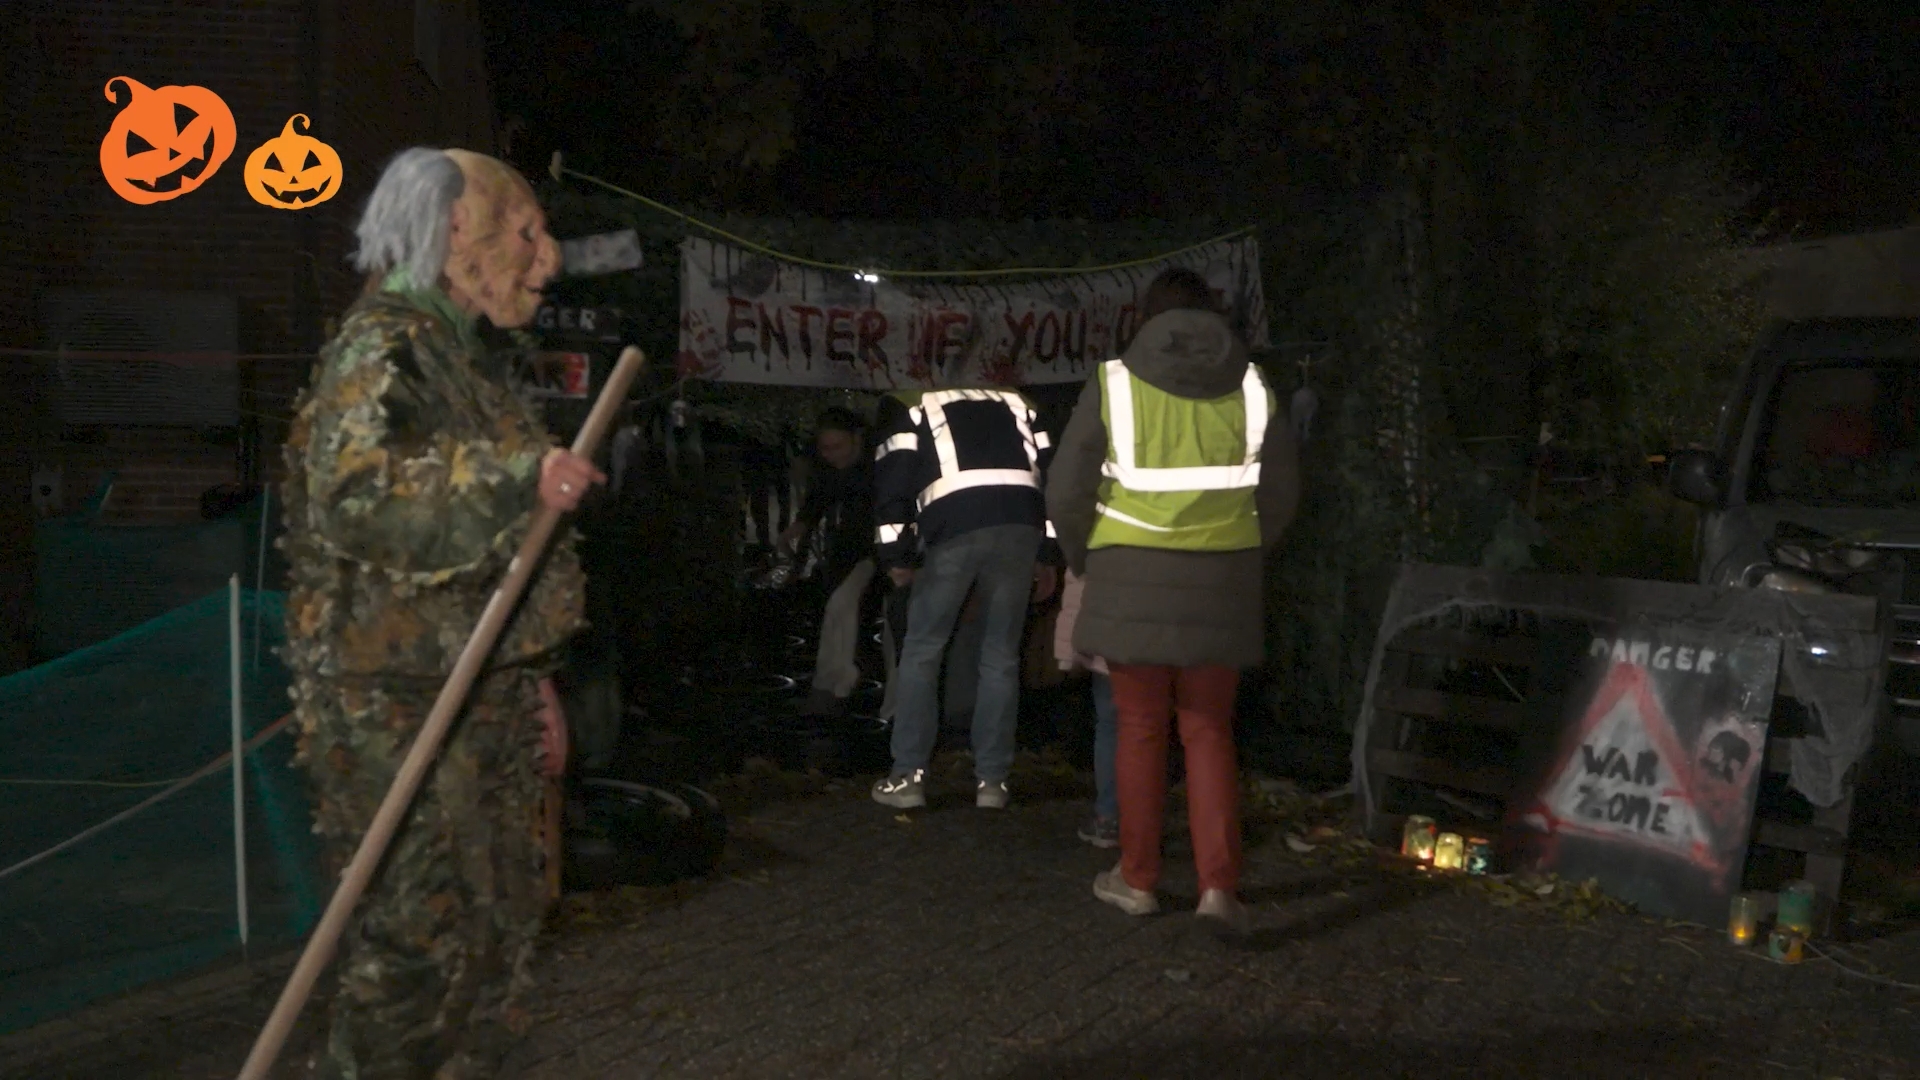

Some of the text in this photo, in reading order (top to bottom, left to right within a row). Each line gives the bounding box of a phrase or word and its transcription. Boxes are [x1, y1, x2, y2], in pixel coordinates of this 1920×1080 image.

[537, 305, 597, 331] GER
[726, 296, 890, 372] ENTER
[1002, 309, 1088, 368] YOU
[1589, 637, 1716, 674] DANGER
[1582, 745, 1659, 786] WAR
[1574, 784, 1670, 833] ZONE
